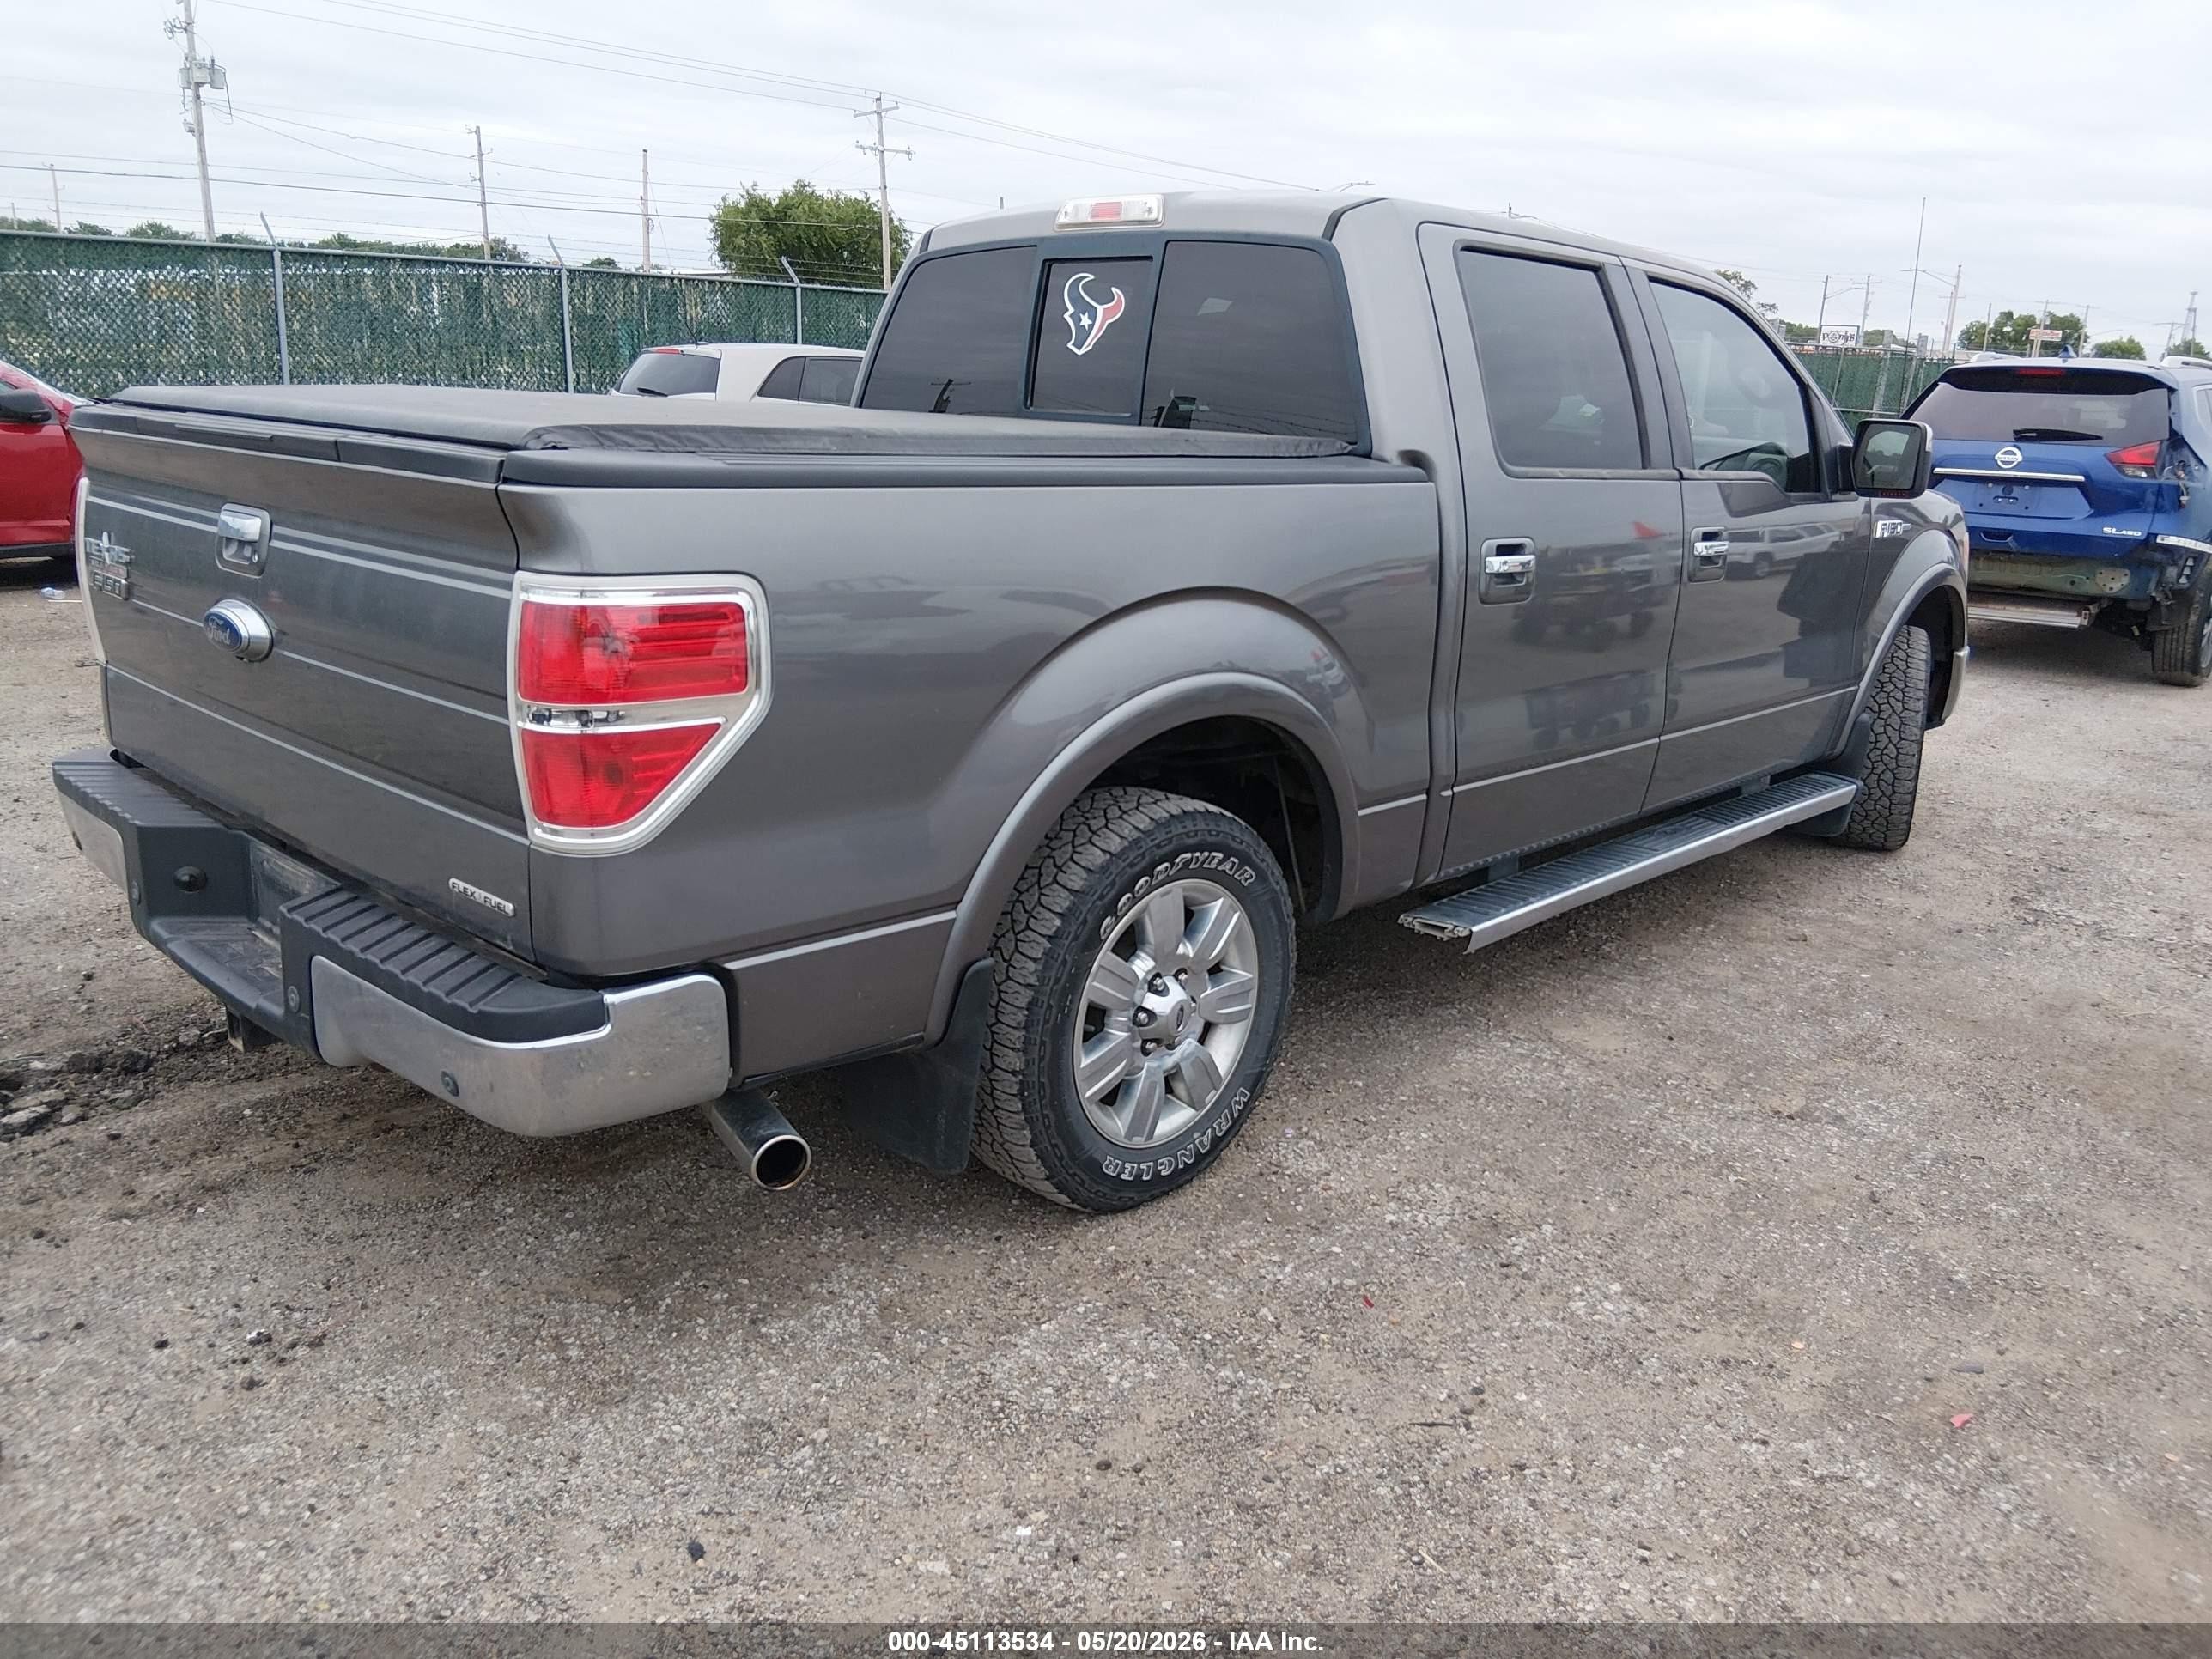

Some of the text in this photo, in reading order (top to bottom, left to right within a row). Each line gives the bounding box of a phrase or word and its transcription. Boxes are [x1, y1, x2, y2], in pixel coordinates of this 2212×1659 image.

[206, 616, 232, 646] Ford
[451, 881, 511, 915] FLEX FUEL
[1099, 851, 1257, 941] GOODYEAR
[1102, 1086, 1251, 1182] WRANGLER
